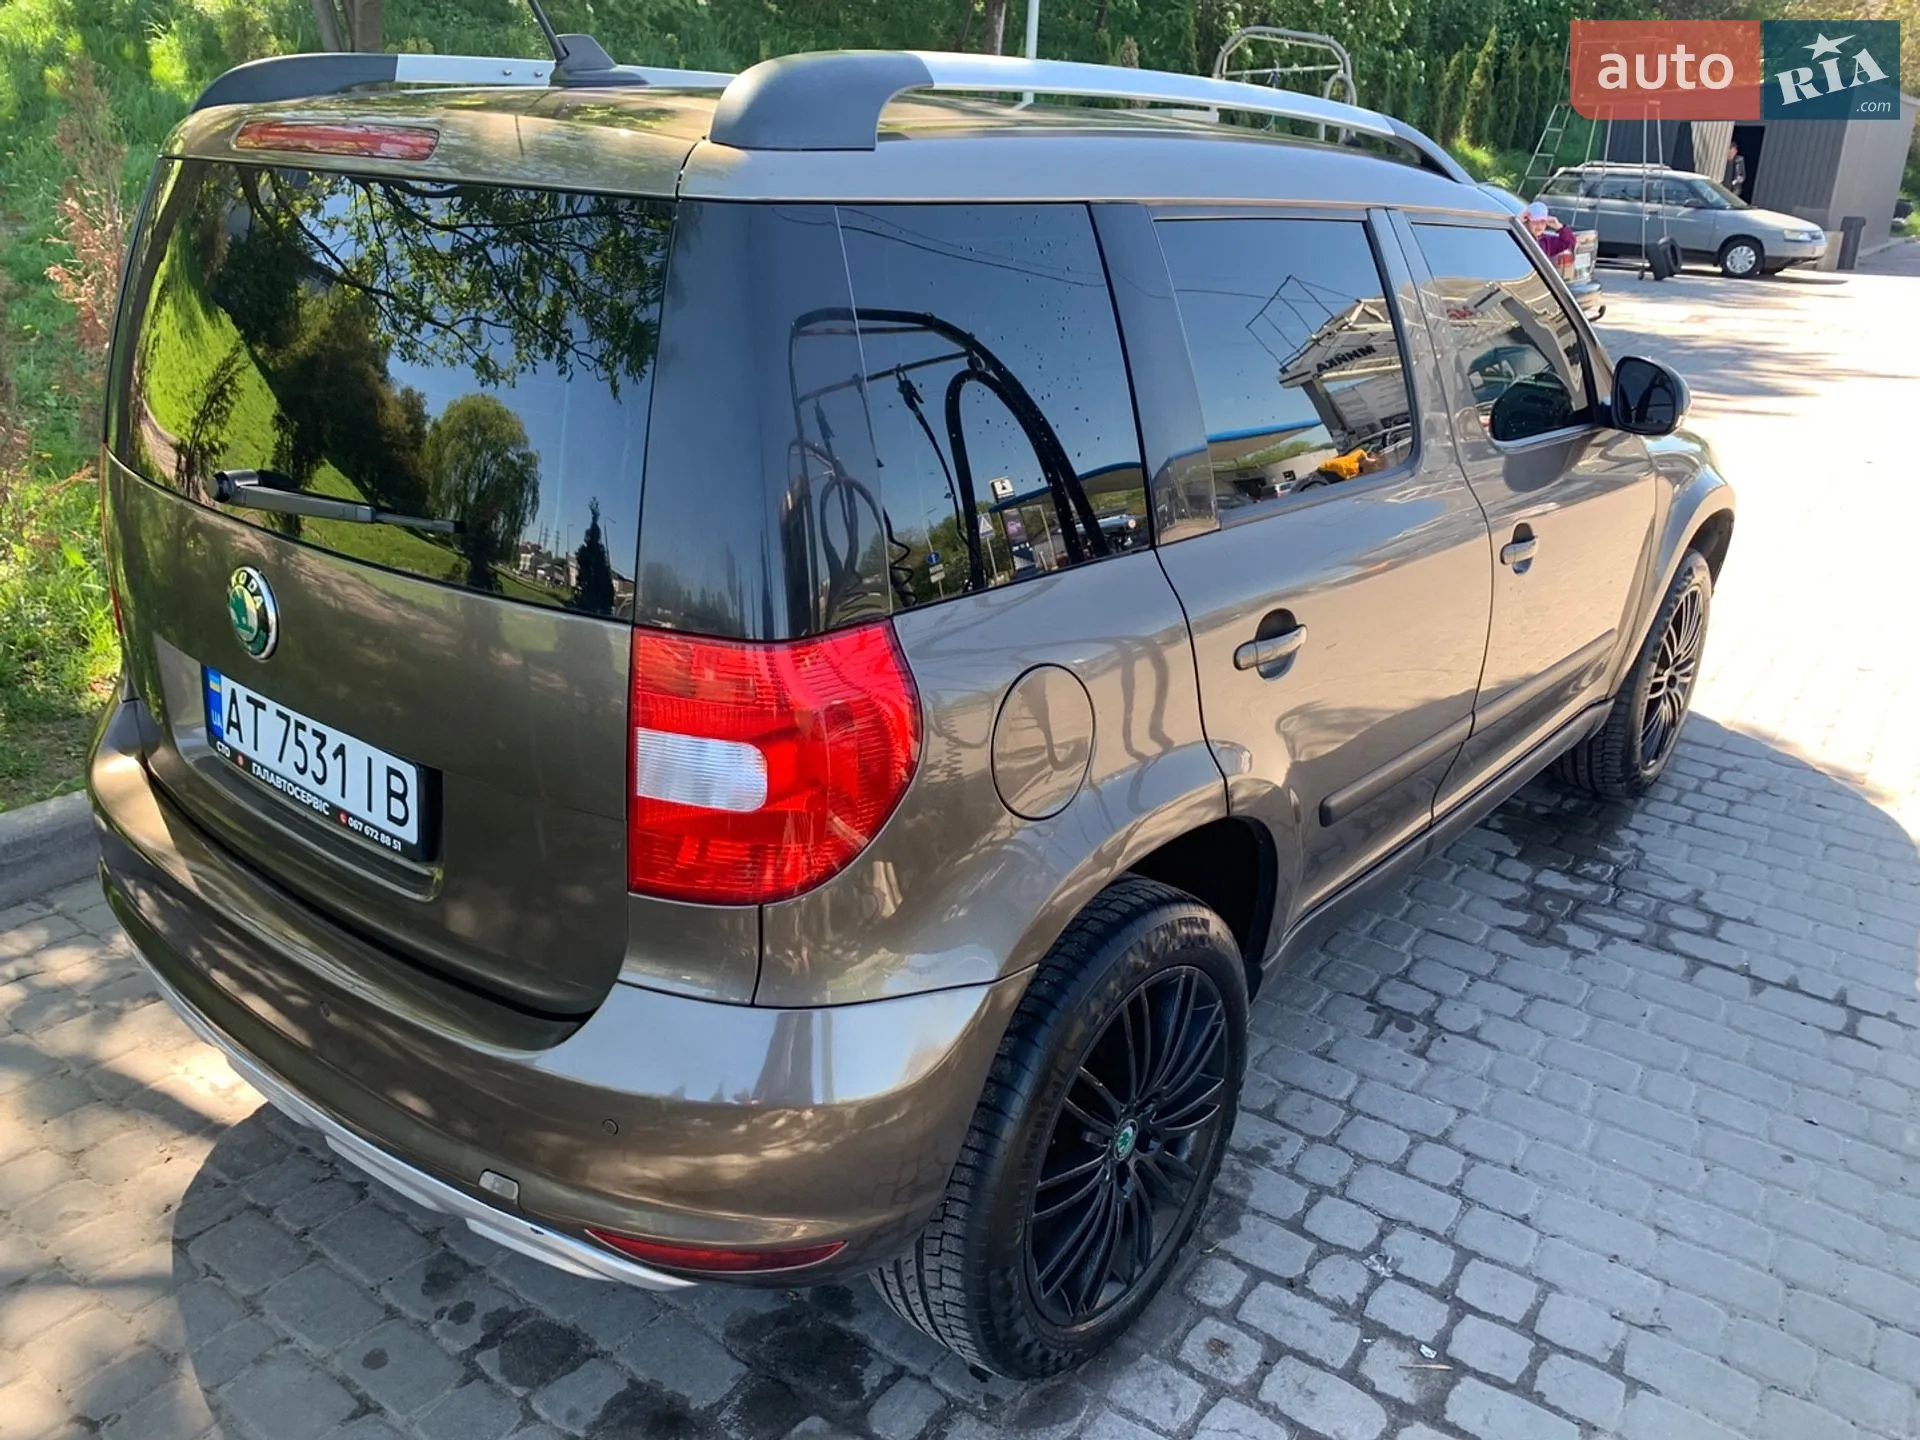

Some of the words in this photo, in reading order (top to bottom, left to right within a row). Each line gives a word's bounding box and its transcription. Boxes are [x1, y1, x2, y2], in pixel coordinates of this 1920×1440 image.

[225, 687, 267, 751] AT
[275, 708, 347, 799] 7531
[367, 756, 409, 827] IB
[347, 816, 363, 831] 067
[364, 825, 379, 840] 672
